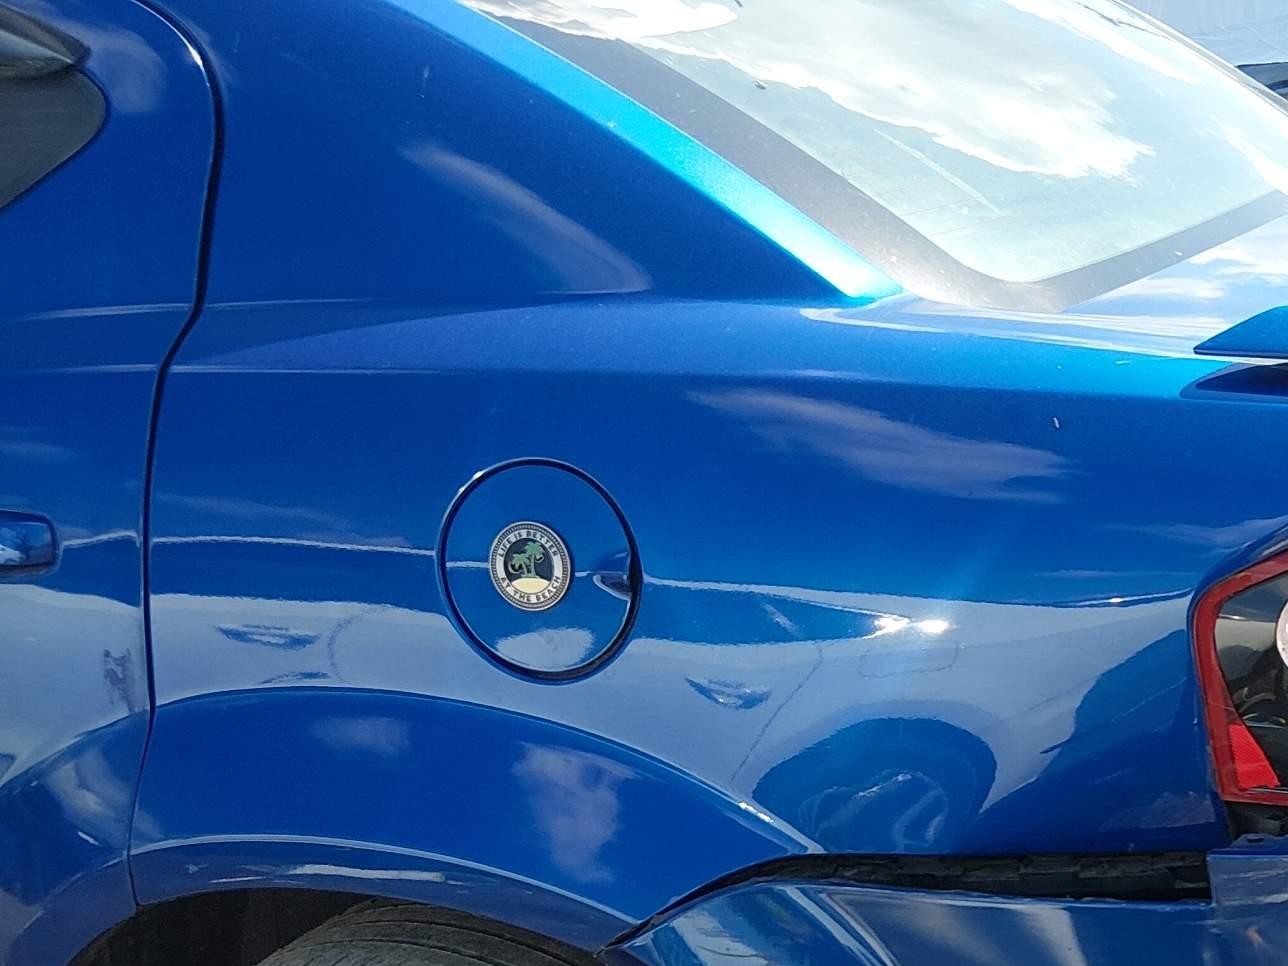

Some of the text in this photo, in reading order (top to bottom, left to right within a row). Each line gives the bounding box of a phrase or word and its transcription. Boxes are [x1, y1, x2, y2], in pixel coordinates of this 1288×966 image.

[499, 530, 559, 558] LIFE IS BETTER
[500, 575, 561, 602] AT THE BEACH
